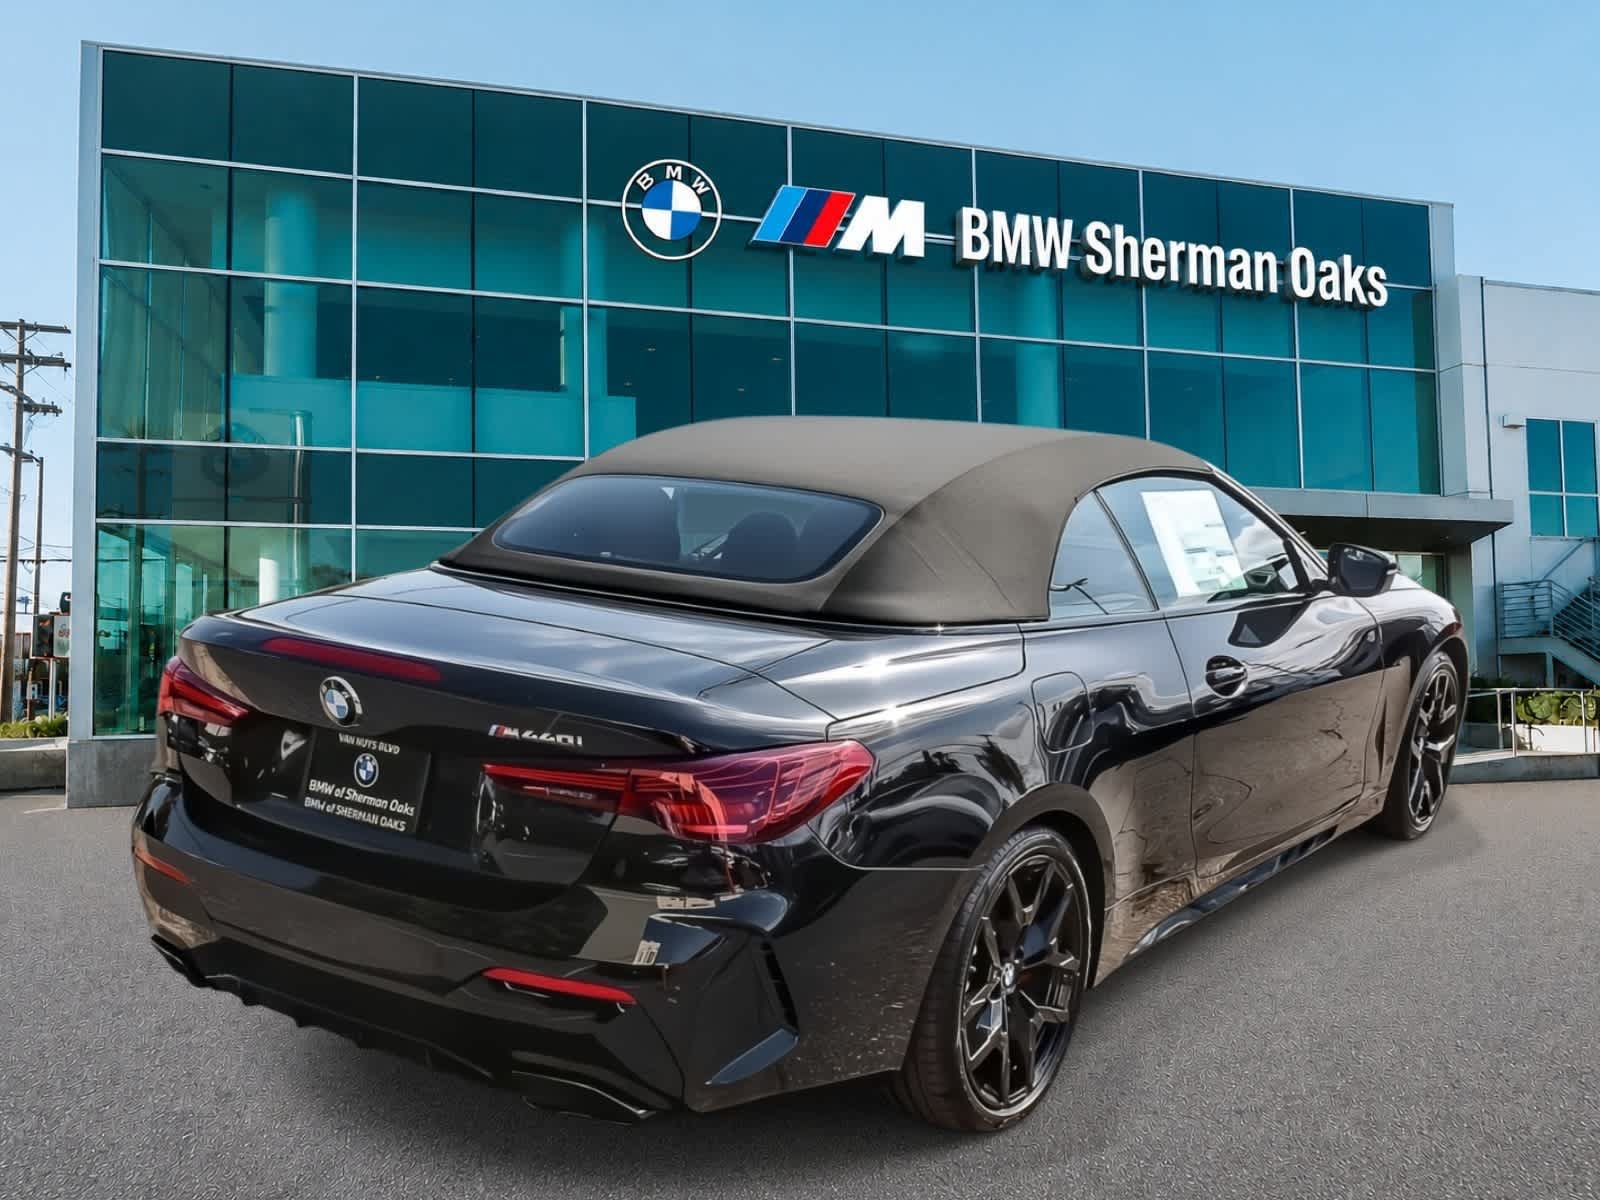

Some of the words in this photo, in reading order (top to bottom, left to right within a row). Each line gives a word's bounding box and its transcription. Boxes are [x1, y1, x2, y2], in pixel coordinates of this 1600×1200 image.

[636, 164, 711, 196] BMW
[835, 194, 925, 257] M
[960, 206, 1073, 270] BMW
[1083, 220, 1278, 294] Sherman
[1288, 246, 1389, 308] Oaks
[338, 733, 355, 745] VAN
[378, 741, 400, 754] BLVD
[304, 797, 326, 811] BMW
[326, 804, 336, 812] of
[335, 806, 380, 825] SHERMAN
[380, 815, 407, 831] OAKS
[308, 779, 336, 795] BMW
[334, 787, 345, 798] of
[344, 788, 392, 809] Sherman
[390, 799, 415, 816] Oaks
